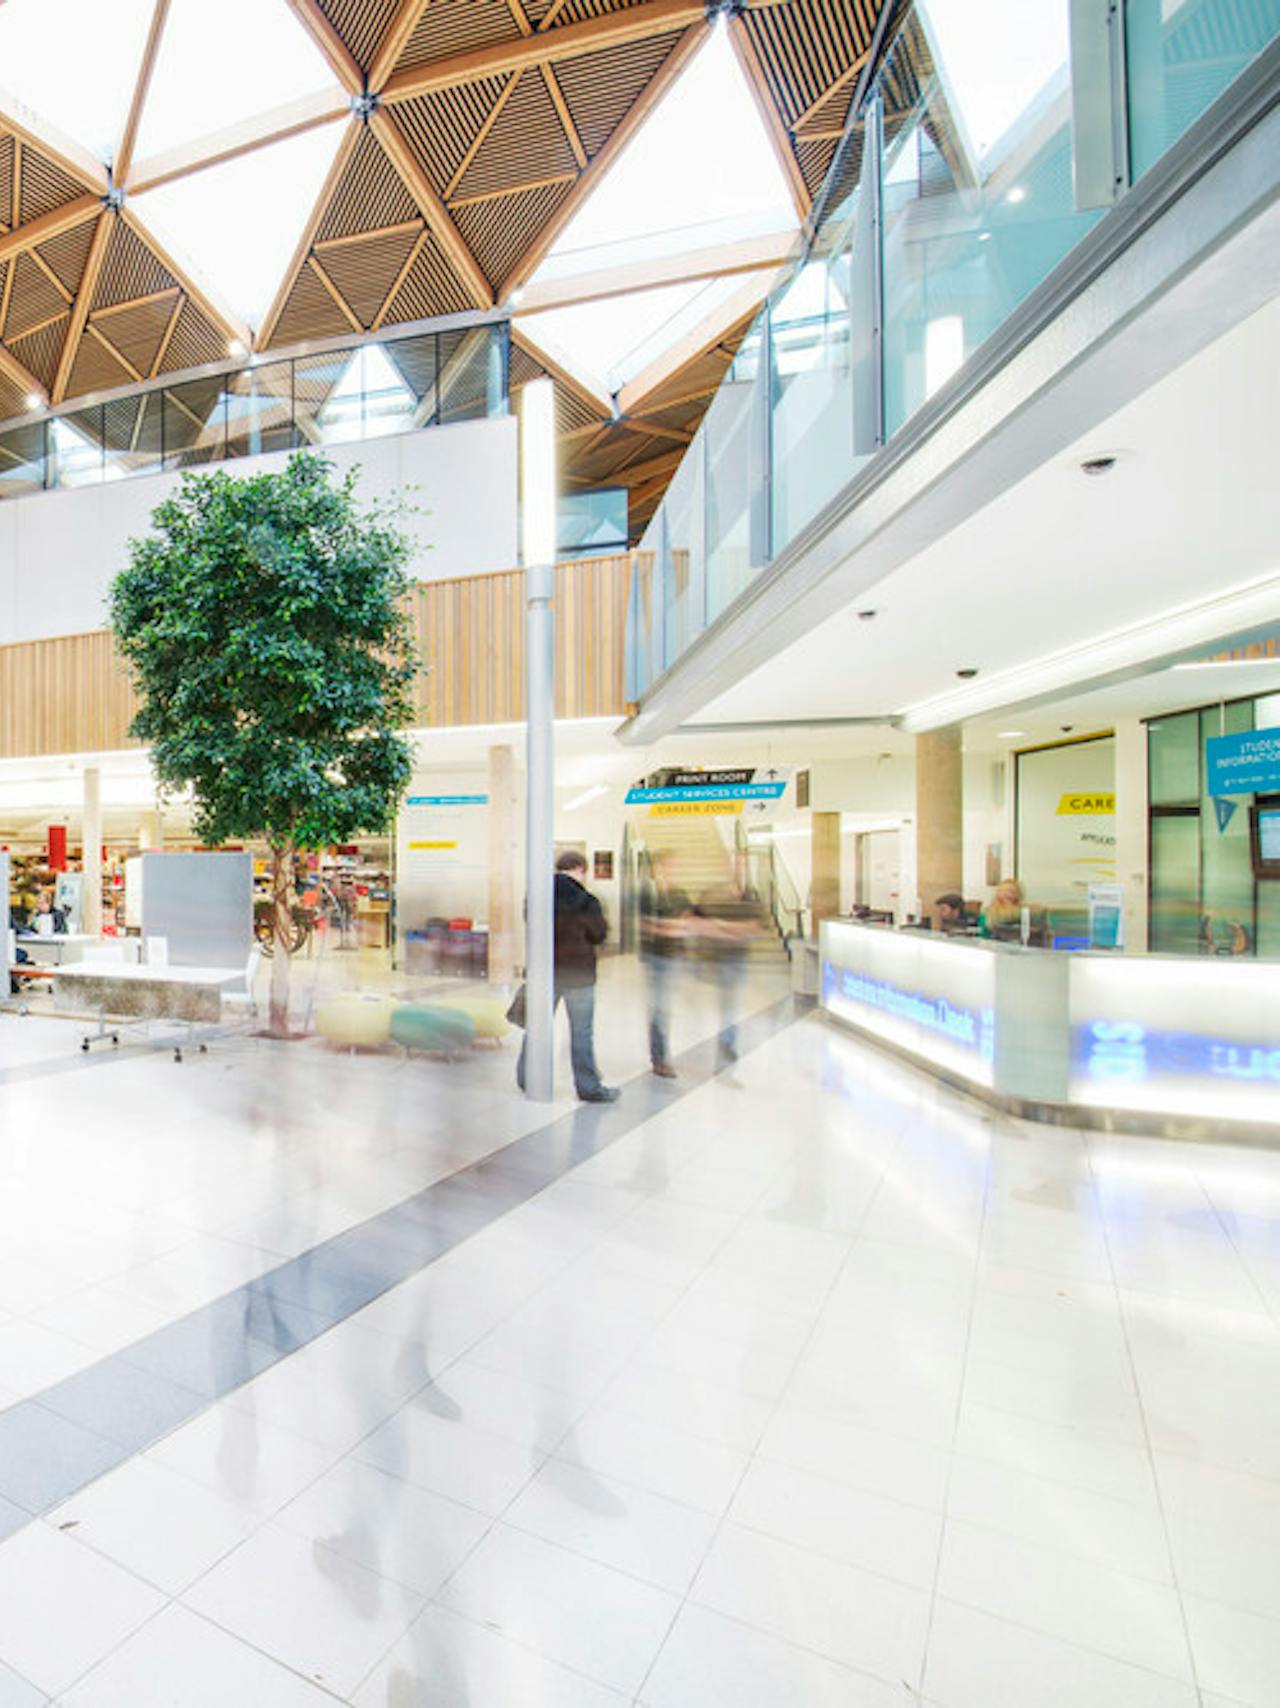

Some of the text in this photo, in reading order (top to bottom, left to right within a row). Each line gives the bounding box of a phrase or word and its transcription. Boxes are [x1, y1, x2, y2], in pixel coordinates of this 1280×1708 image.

[675, 772, 748, 784] PRINT ROOM
[631, 786, 777, 800] STUDENT SERVICES CENTRE
[657, 803, 735, 814] CAREER ZONE
